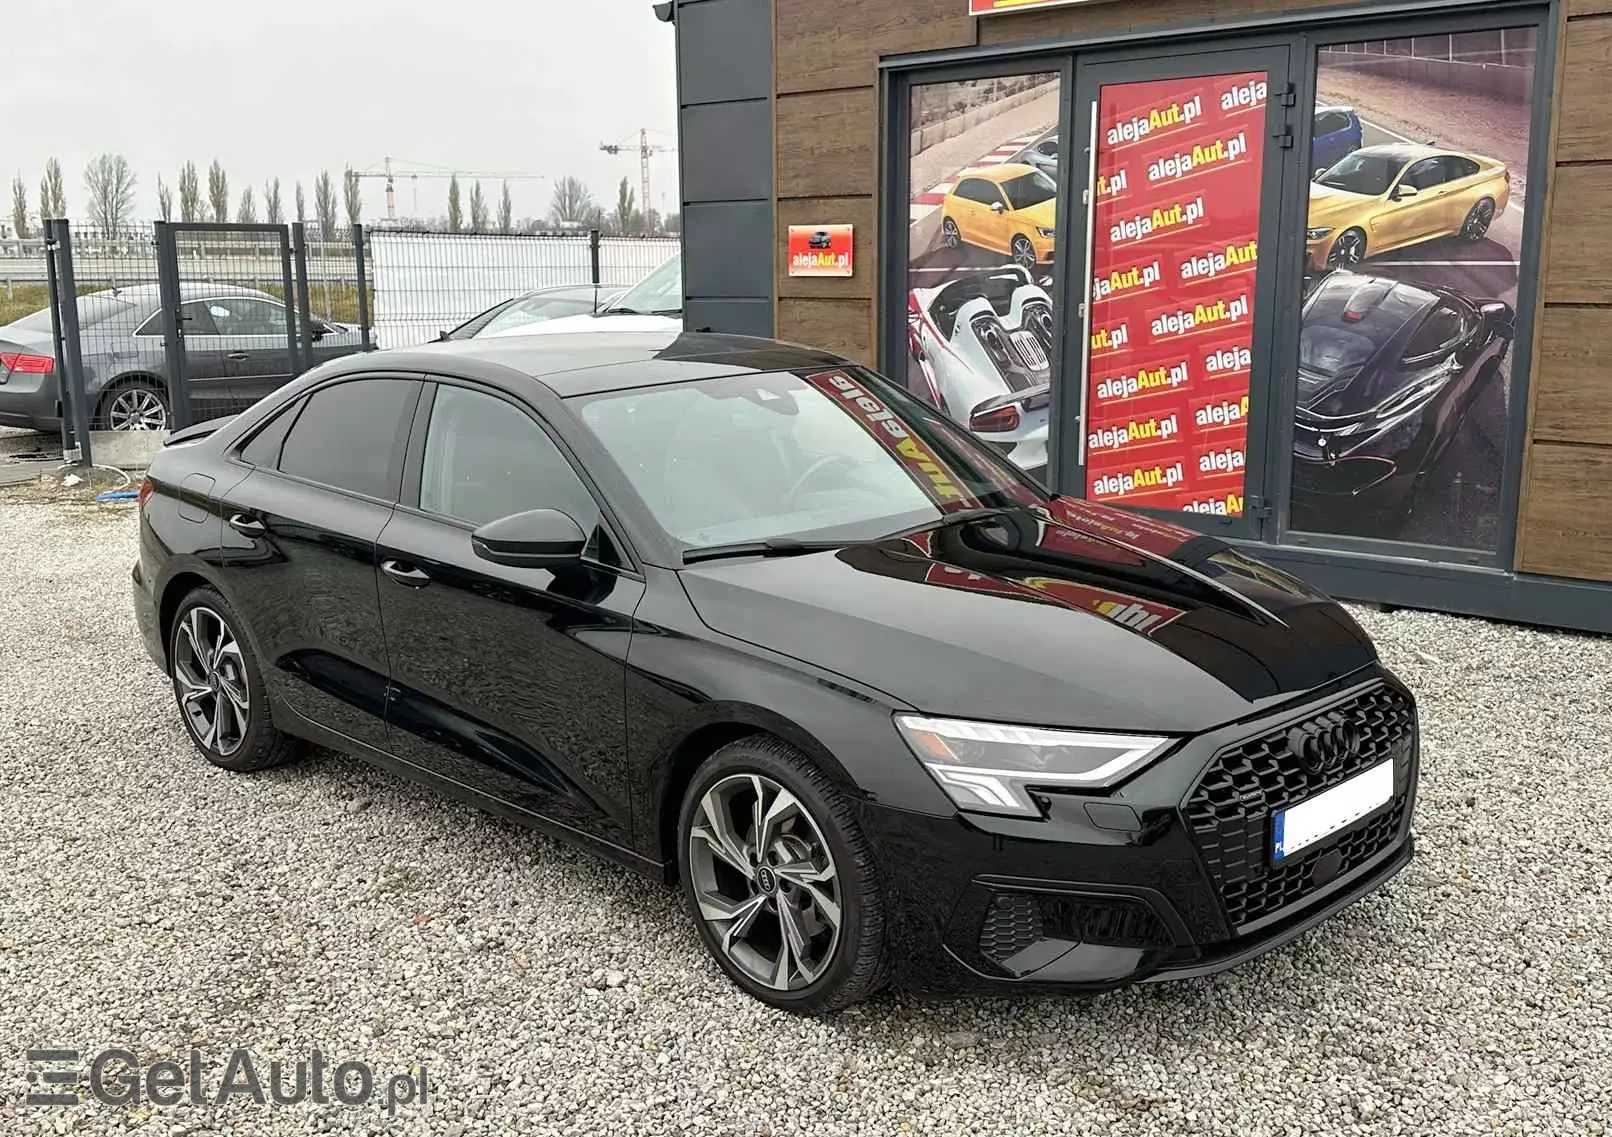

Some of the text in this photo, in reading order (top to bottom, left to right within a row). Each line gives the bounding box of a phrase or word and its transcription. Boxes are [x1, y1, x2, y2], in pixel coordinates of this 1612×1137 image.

[1220, 80, 1267, 110] aleja
[1107, 96, 1202, 145] alejaAut.pl
[1148, 132, 1247, 181] alejaAut.pl
[1110, 197, 1204, 243] alejaAut.pl
[792, 252, 849, 269] alejaAut.pl
[1093, 261, 1161, 301] jaAut.pl
[1152, 295, 1248, 336] alejaAut.pl
[1206, 346, 1251, 372] aleja
[1097, 361, 1188, 399] alejaAut.pl
[1088, 414, 1178, 449] alejaAut.pl
[1199, 448, 1244, 472] aleja
[1094, 463, 1183, 495] alejaAut.pl
